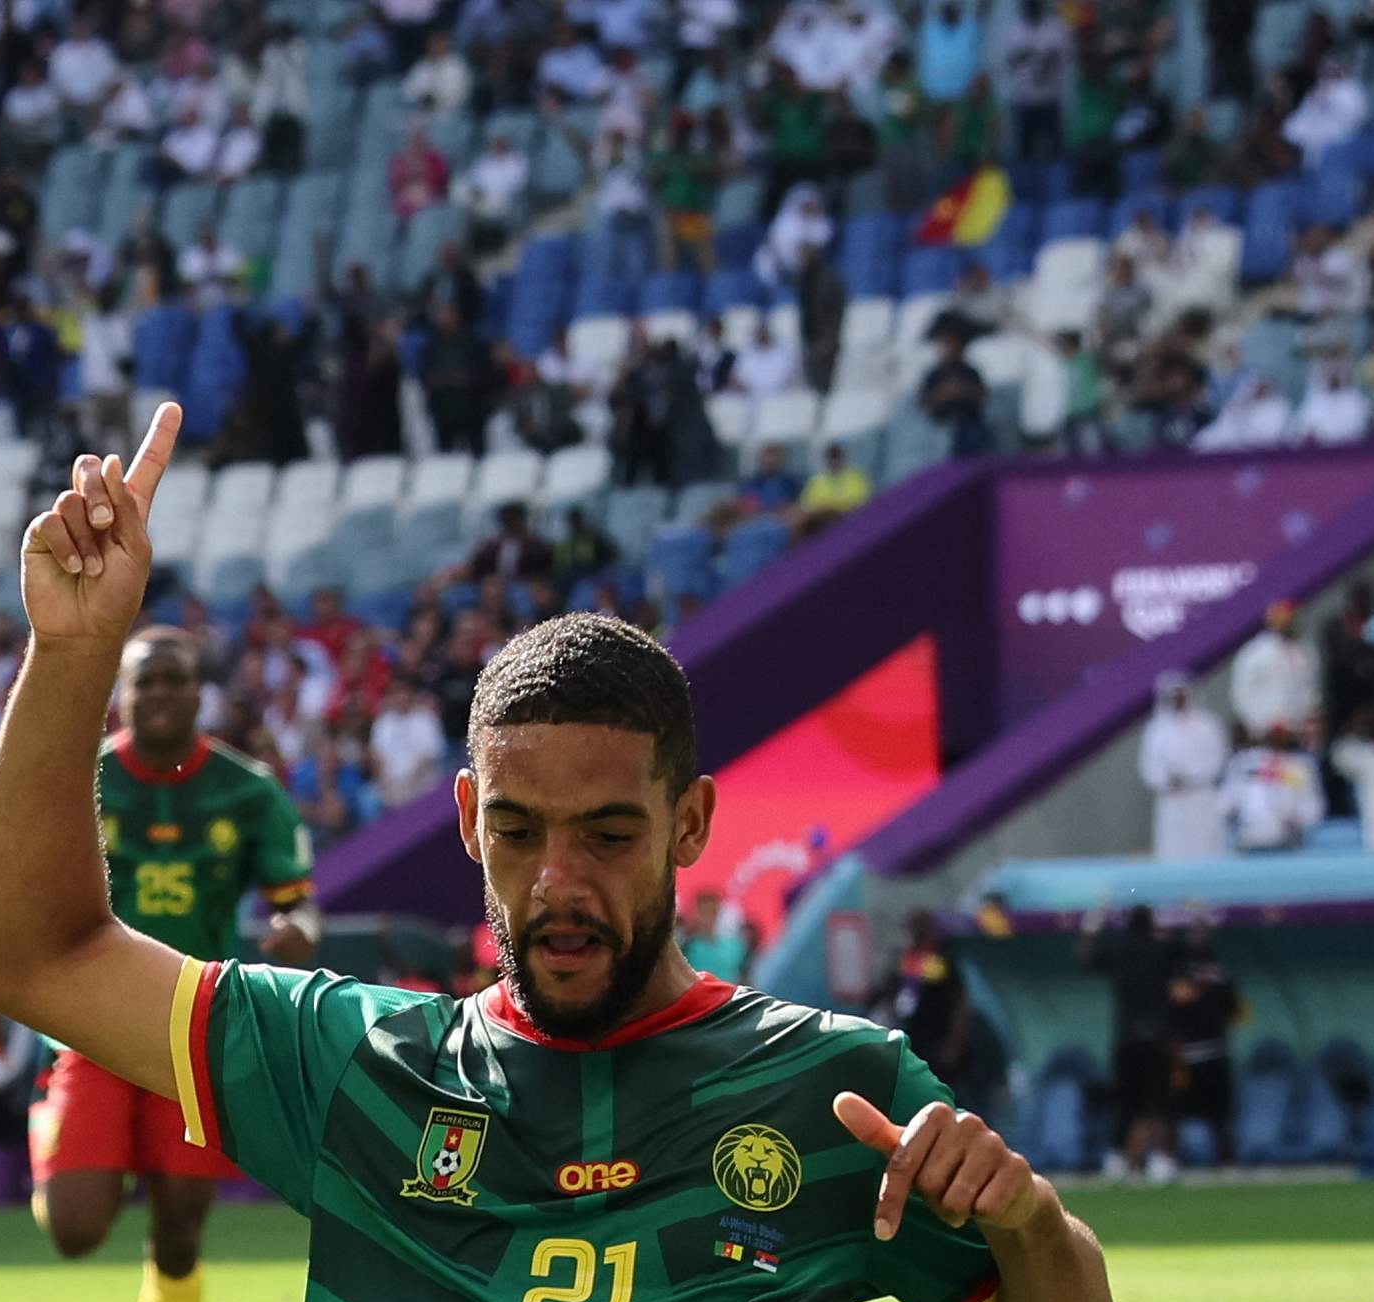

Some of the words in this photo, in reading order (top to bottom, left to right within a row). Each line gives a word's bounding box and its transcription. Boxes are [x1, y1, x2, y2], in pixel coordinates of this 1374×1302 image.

[136, 862, 196, 915] 25
[435, 1114, 482, 1129] CAMEROUN
[559, 1161, 637, 1192] one
